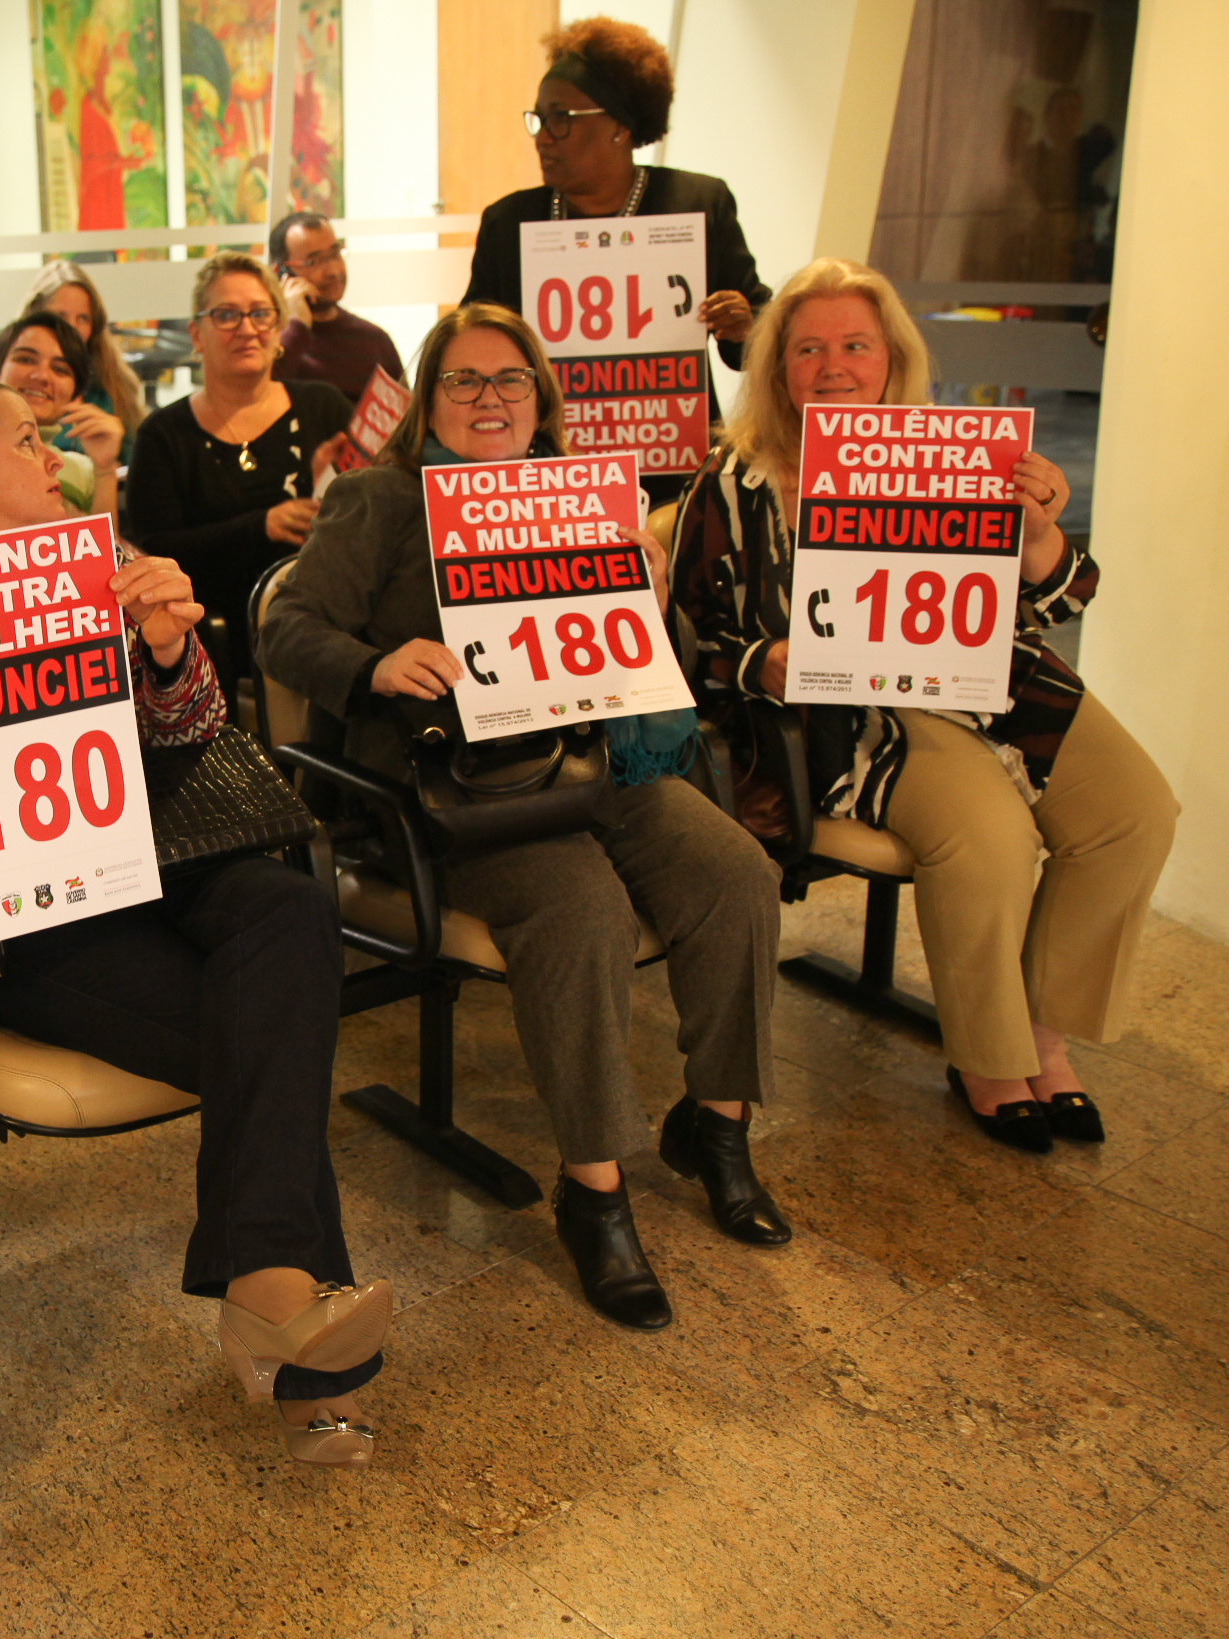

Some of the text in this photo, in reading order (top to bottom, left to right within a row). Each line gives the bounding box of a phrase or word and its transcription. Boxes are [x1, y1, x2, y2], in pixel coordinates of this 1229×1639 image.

[537, 274, 653, 343] 180
[550, 356, 697, 393] DENUNCI
[563, 397, 698, 423] A MULHE
[816, 409, 1019, 441] VIOLÊNCIA
[837, 442, 992, 470] CONTRA
[434, 460, 628, 497] VIOLÊNCIA
[811, 471, 1016, 500] A MULHER:
[460, 492, 606, 525] CONTRA
[442, 520, 630, 554] A MULHER
[808, 506, 1012, 549] DENUNCIE!
[446, 553, 641, 600] DENUNCIE!
[855, 569, 998, 648] 180
[509, 607, 653, 682] 180
